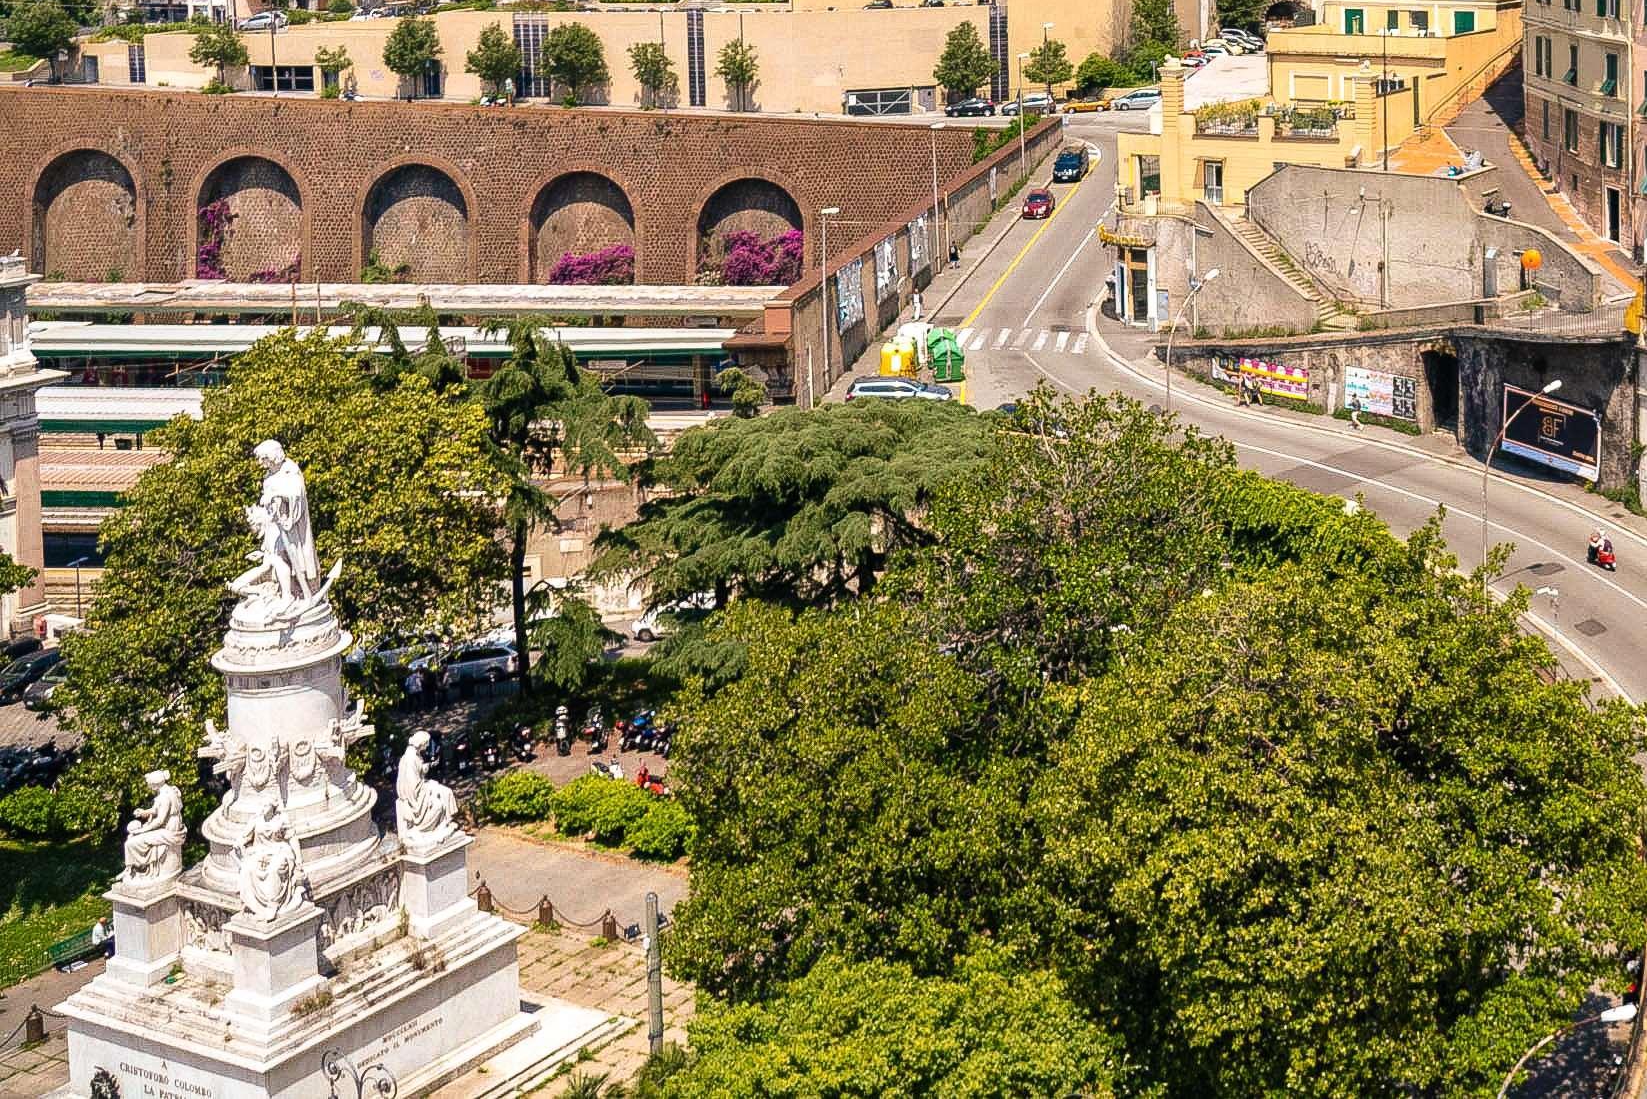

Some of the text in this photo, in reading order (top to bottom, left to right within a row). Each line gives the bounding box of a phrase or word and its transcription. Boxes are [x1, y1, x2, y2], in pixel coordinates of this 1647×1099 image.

[161, 1060, 168, 1070] A
[119, 1061, 213, 1098] CRISTOFORO COLOMBO
[143, 1084, 155, 1097] LA
